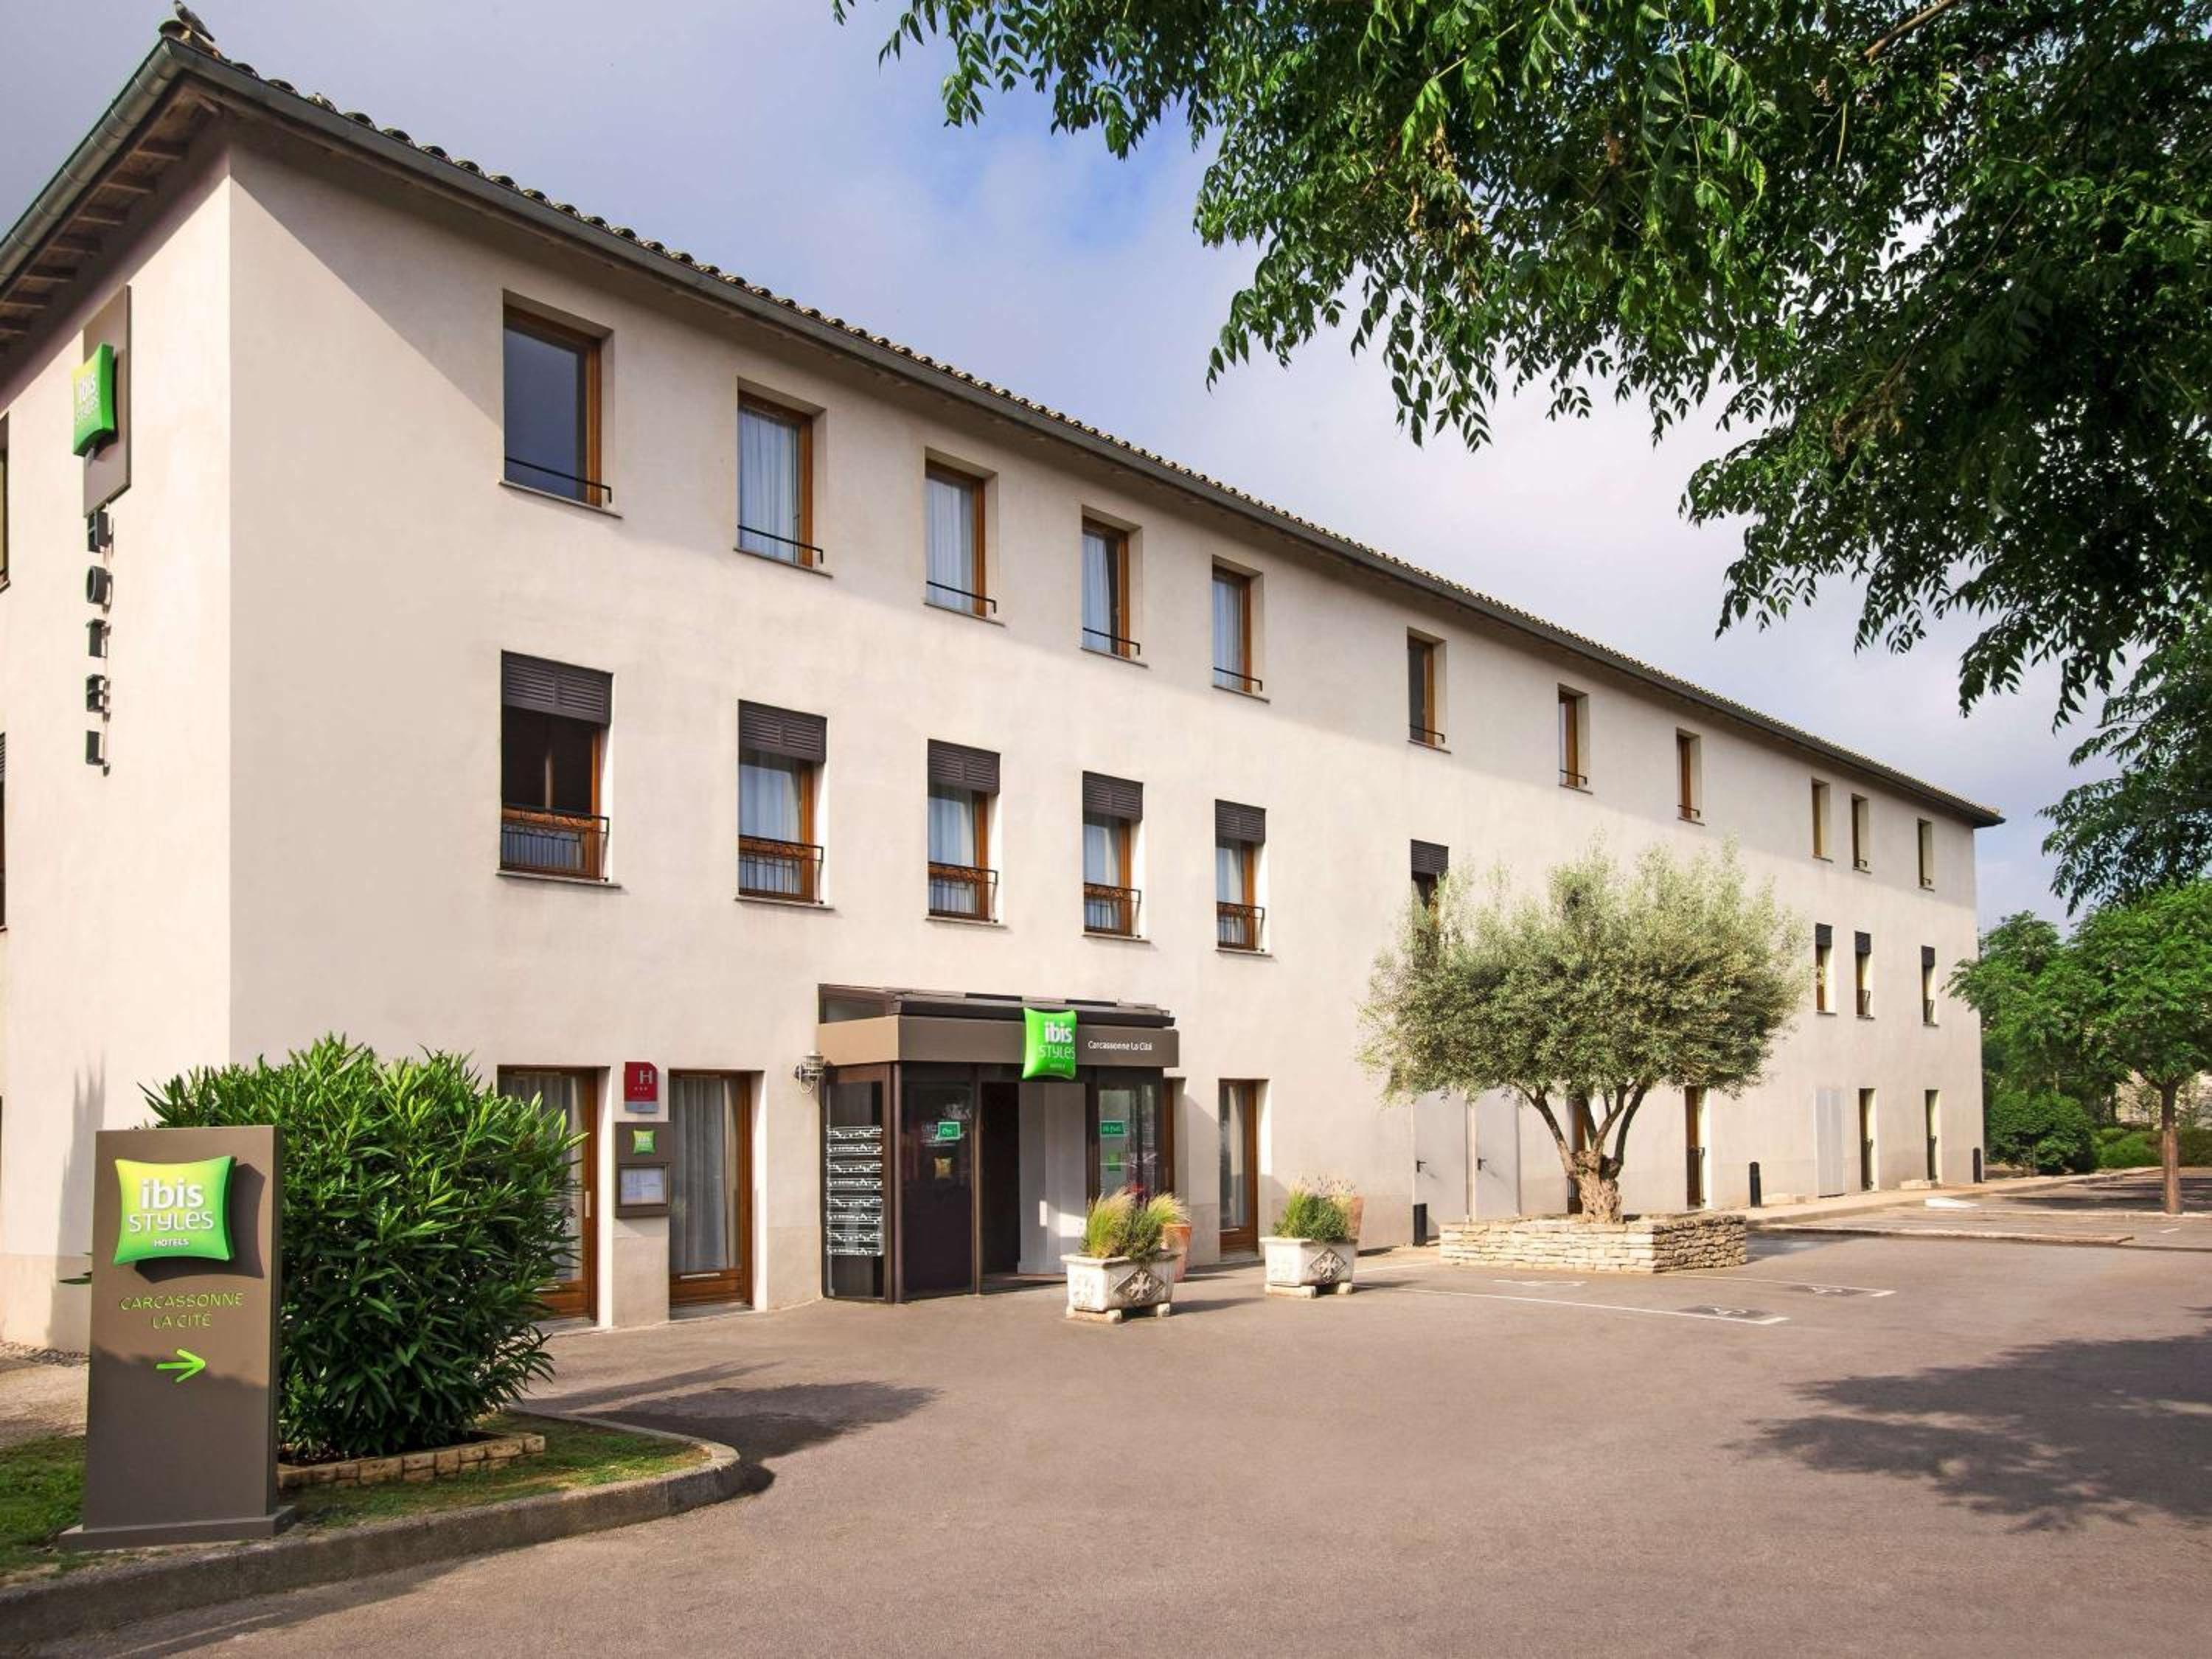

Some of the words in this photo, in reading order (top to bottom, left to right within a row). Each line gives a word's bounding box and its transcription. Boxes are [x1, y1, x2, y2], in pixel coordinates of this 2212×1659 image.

[1044, 1021, 1073, 1044] ibis
[639, 1070, 653, 1085] H
[141, 1178, 204, 1210] ibis
[153, 1238, 189, 1247] HOTELS
[120, 1293, 244, 1310] CARCASSONNE
[153, 1315, 173, 1329] LA
[177, 1310, 212, 1327] CITÉ
